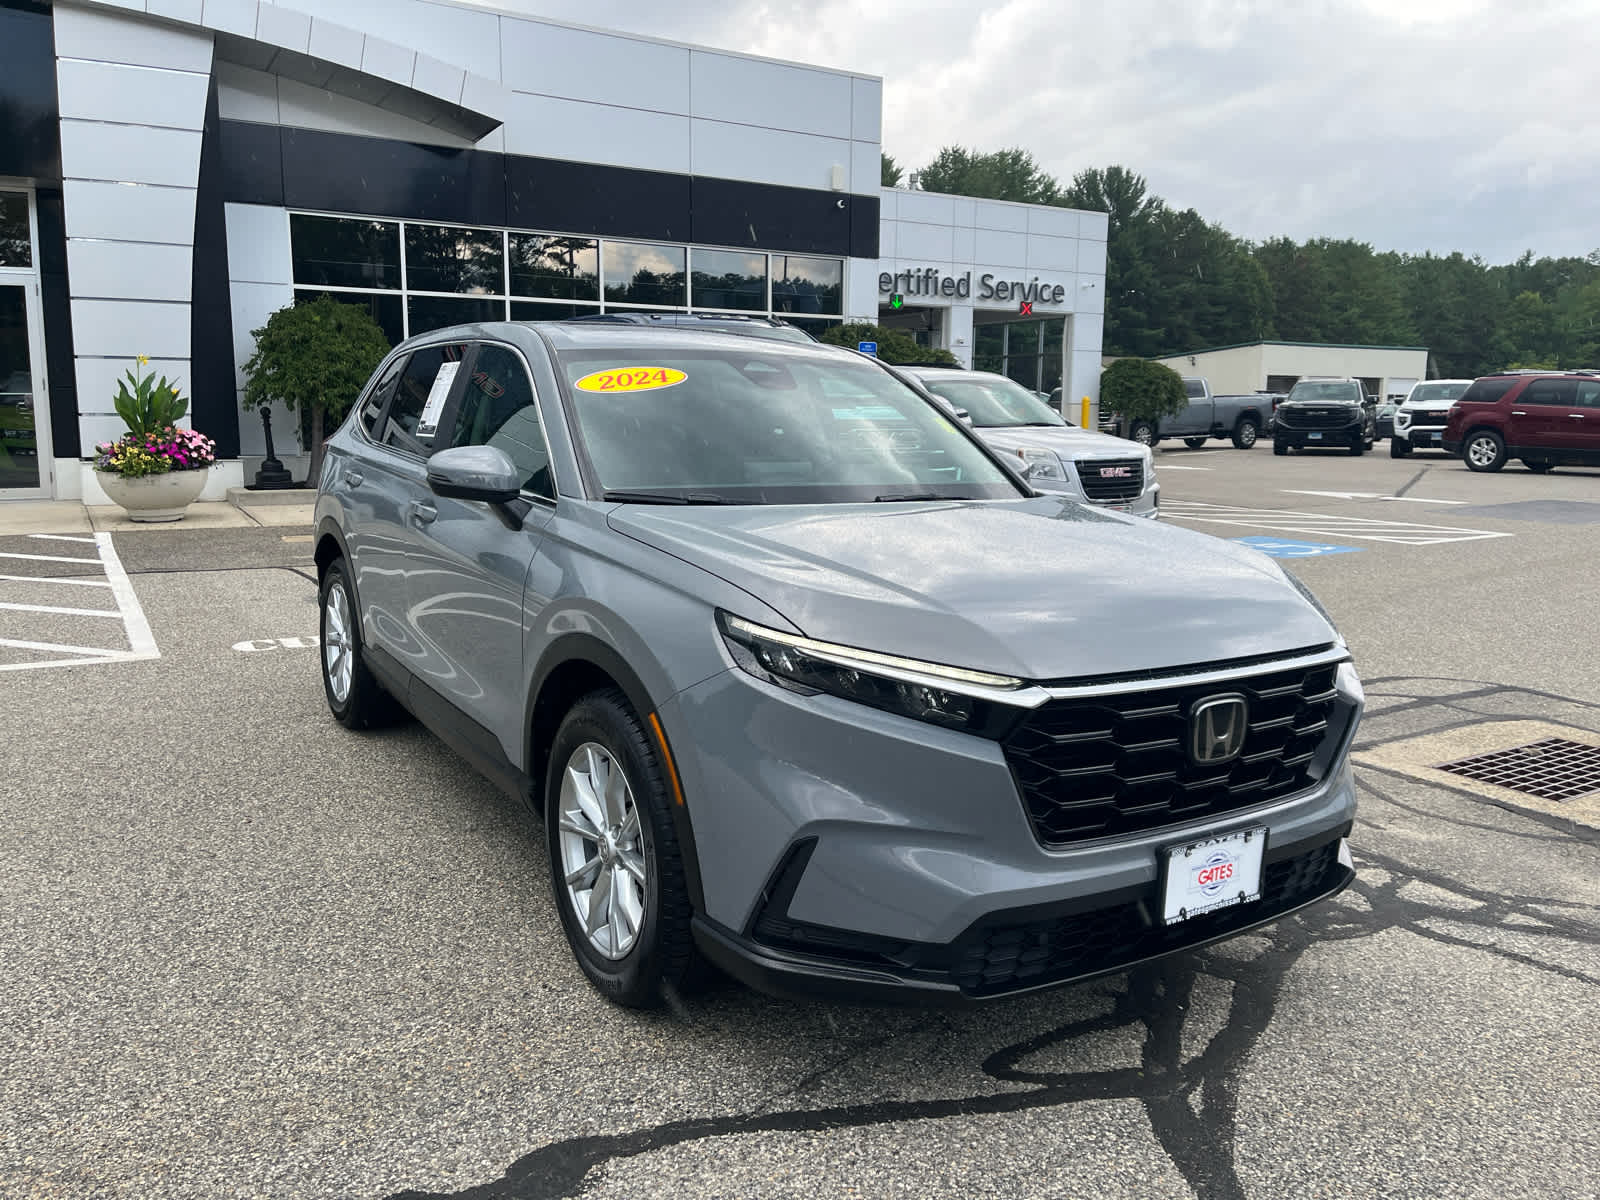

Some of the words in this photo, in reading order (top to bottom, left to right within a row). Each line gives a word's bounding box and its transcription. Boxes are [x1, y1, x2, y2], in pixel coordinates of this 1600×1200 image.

[980, 273, 1065, 304] Service
[598, 369, 670, 390] 2024
[1100, 466, 1132, 478] GMC
[1198, 863, 1233, 885] GATES
